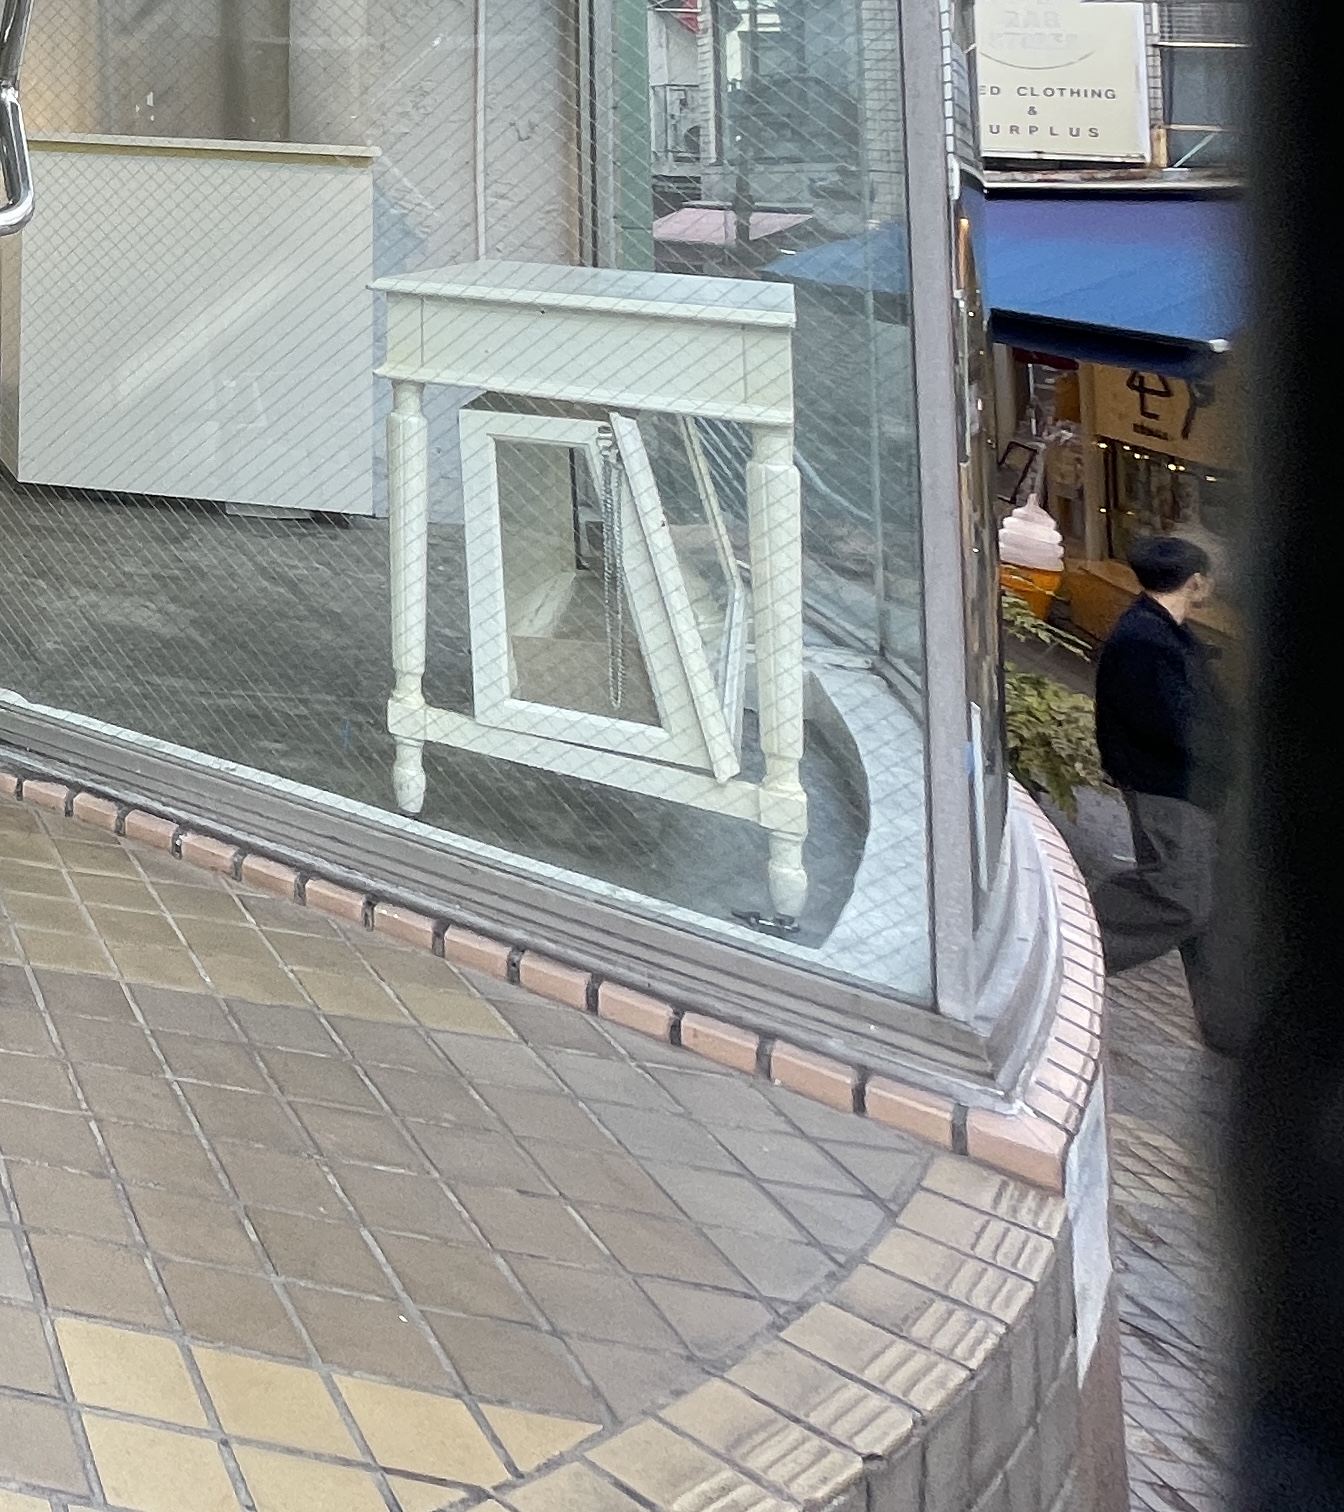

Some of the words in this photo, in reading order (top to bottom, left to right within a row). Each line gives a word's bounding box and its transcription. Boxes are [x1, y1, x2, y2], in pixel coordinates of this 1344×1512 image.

[1016, 85, 1117, 100] CLOTHING
[1027, 105, 1038, 116] &
[989, 124, 1100, 138] URPLUS
